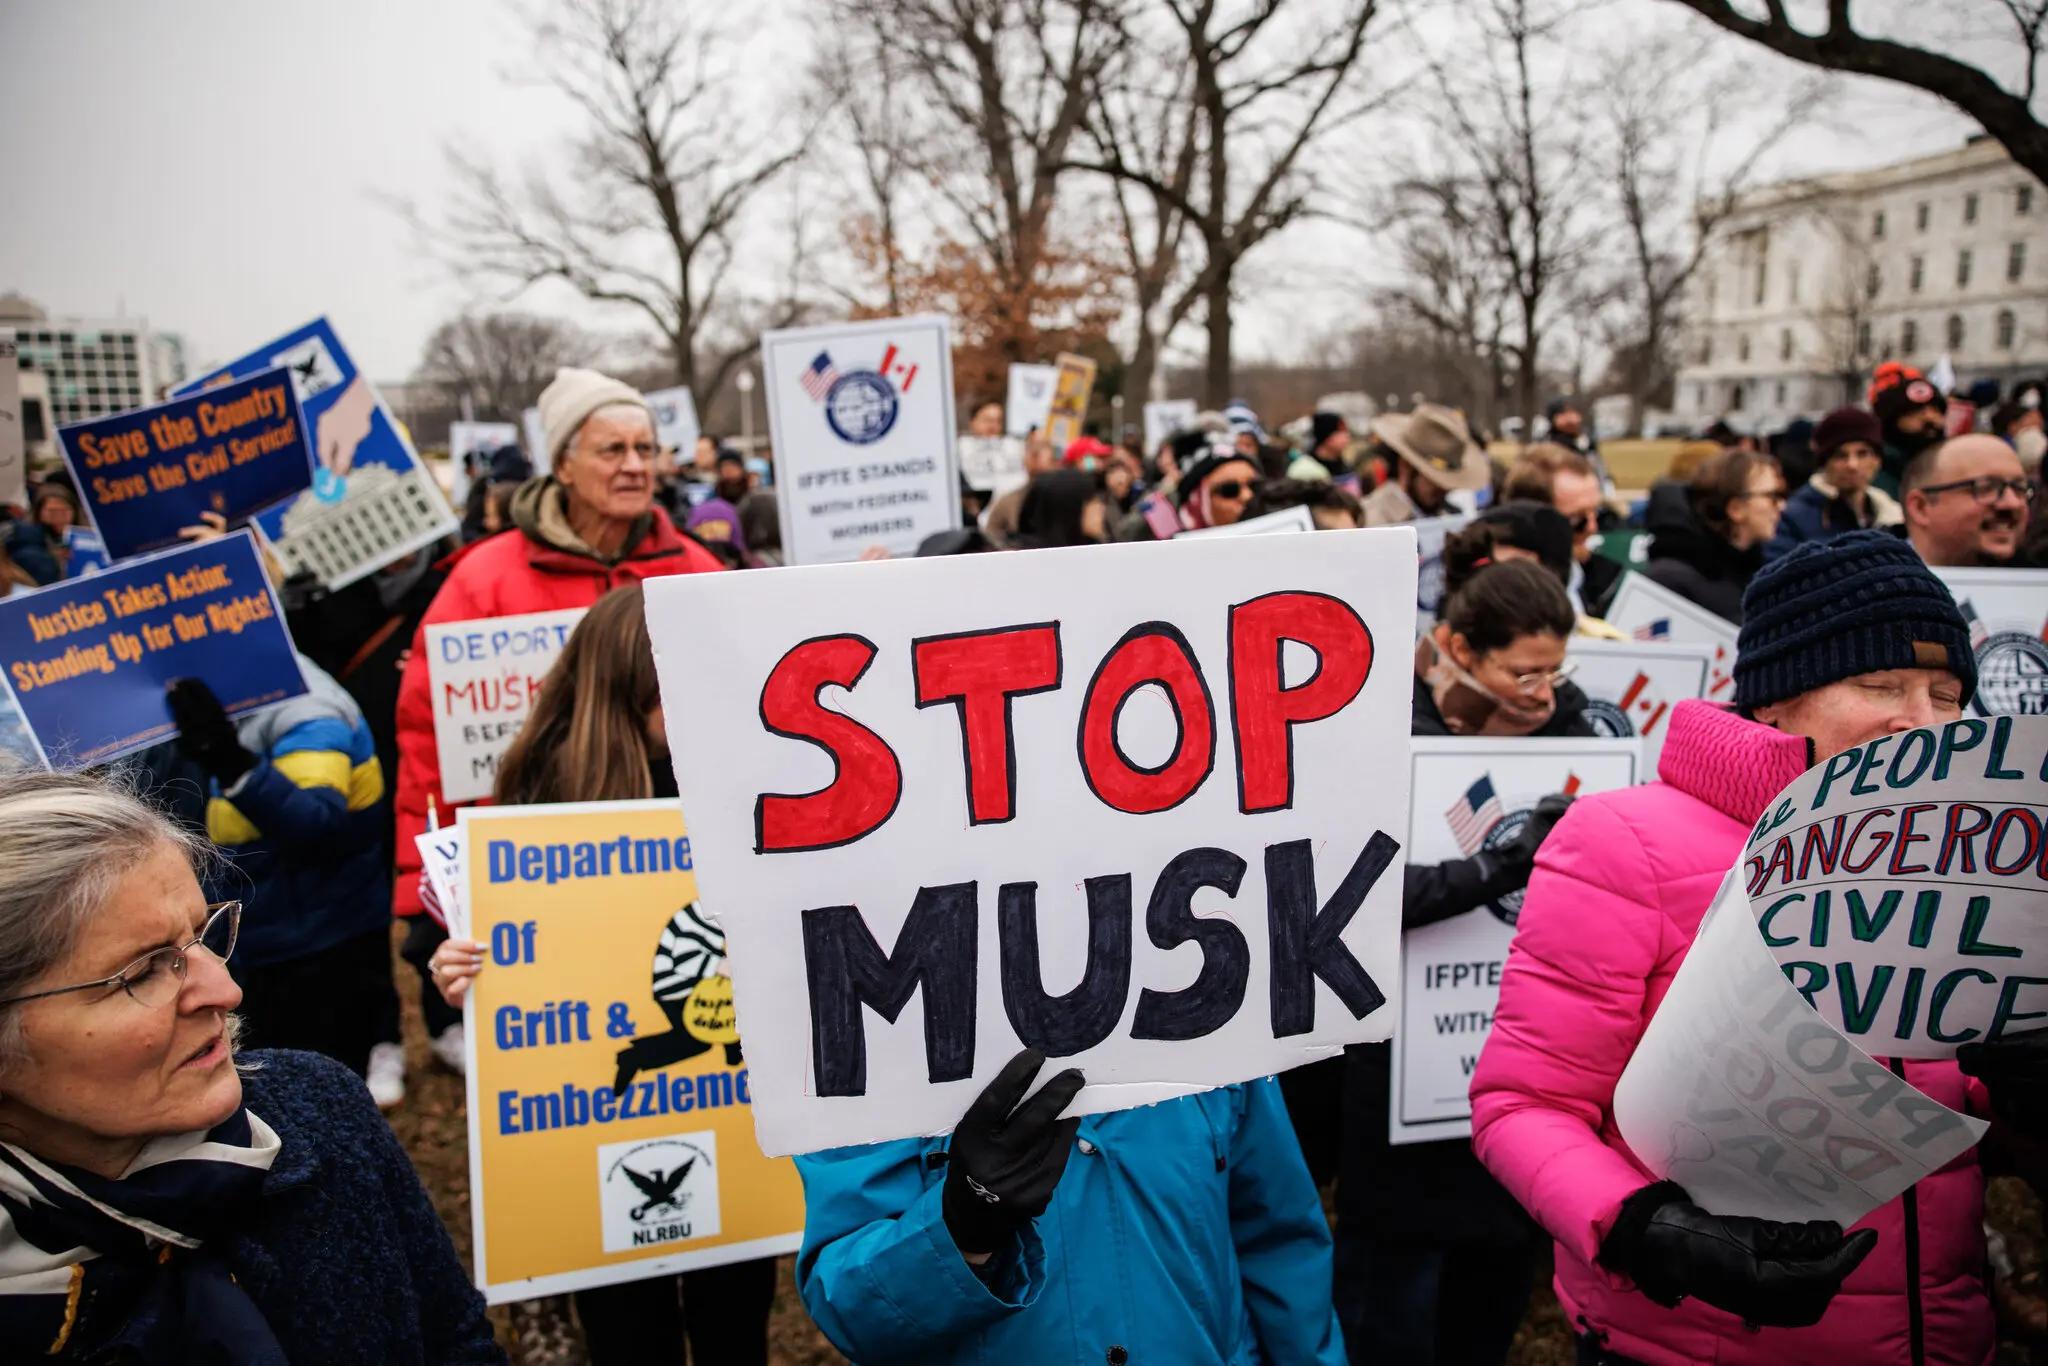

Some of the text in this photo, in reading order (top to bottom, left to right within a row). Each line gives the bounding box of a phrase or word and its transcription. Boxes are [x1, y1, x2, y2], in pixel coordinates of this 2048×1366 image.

[78, 430, 149, 468] Save
[150, 414, 198, 451] the
[196, 384, 287, 437] Country
[92, 474, 148, 504] Save
[149, 463, 187, 492] the
[185, 444, 230, 481] Civil
[11, 589, 274, 692] Standing Up for Our Rights!
[28, 601, 108, 643] Justice
[104, 582, 168, 618] Takes
[441, 624, 569, 664] DEPORT
[753, 589, 1374, 854] STOP
[1811, 716, 2048, 811] PEOPL
[488, 835, 692, 885] Departme
[491, 920, 538, 967] Of
[1757, 889, 2024, 958] CIVIL
[801, 829, 1402, 1097] MUSK
[1425, 961, 1502, 990] IFPTE
[494, 1000, 636, 1050] Grift &
[632, 1222, 692, 1246] NLRBU
